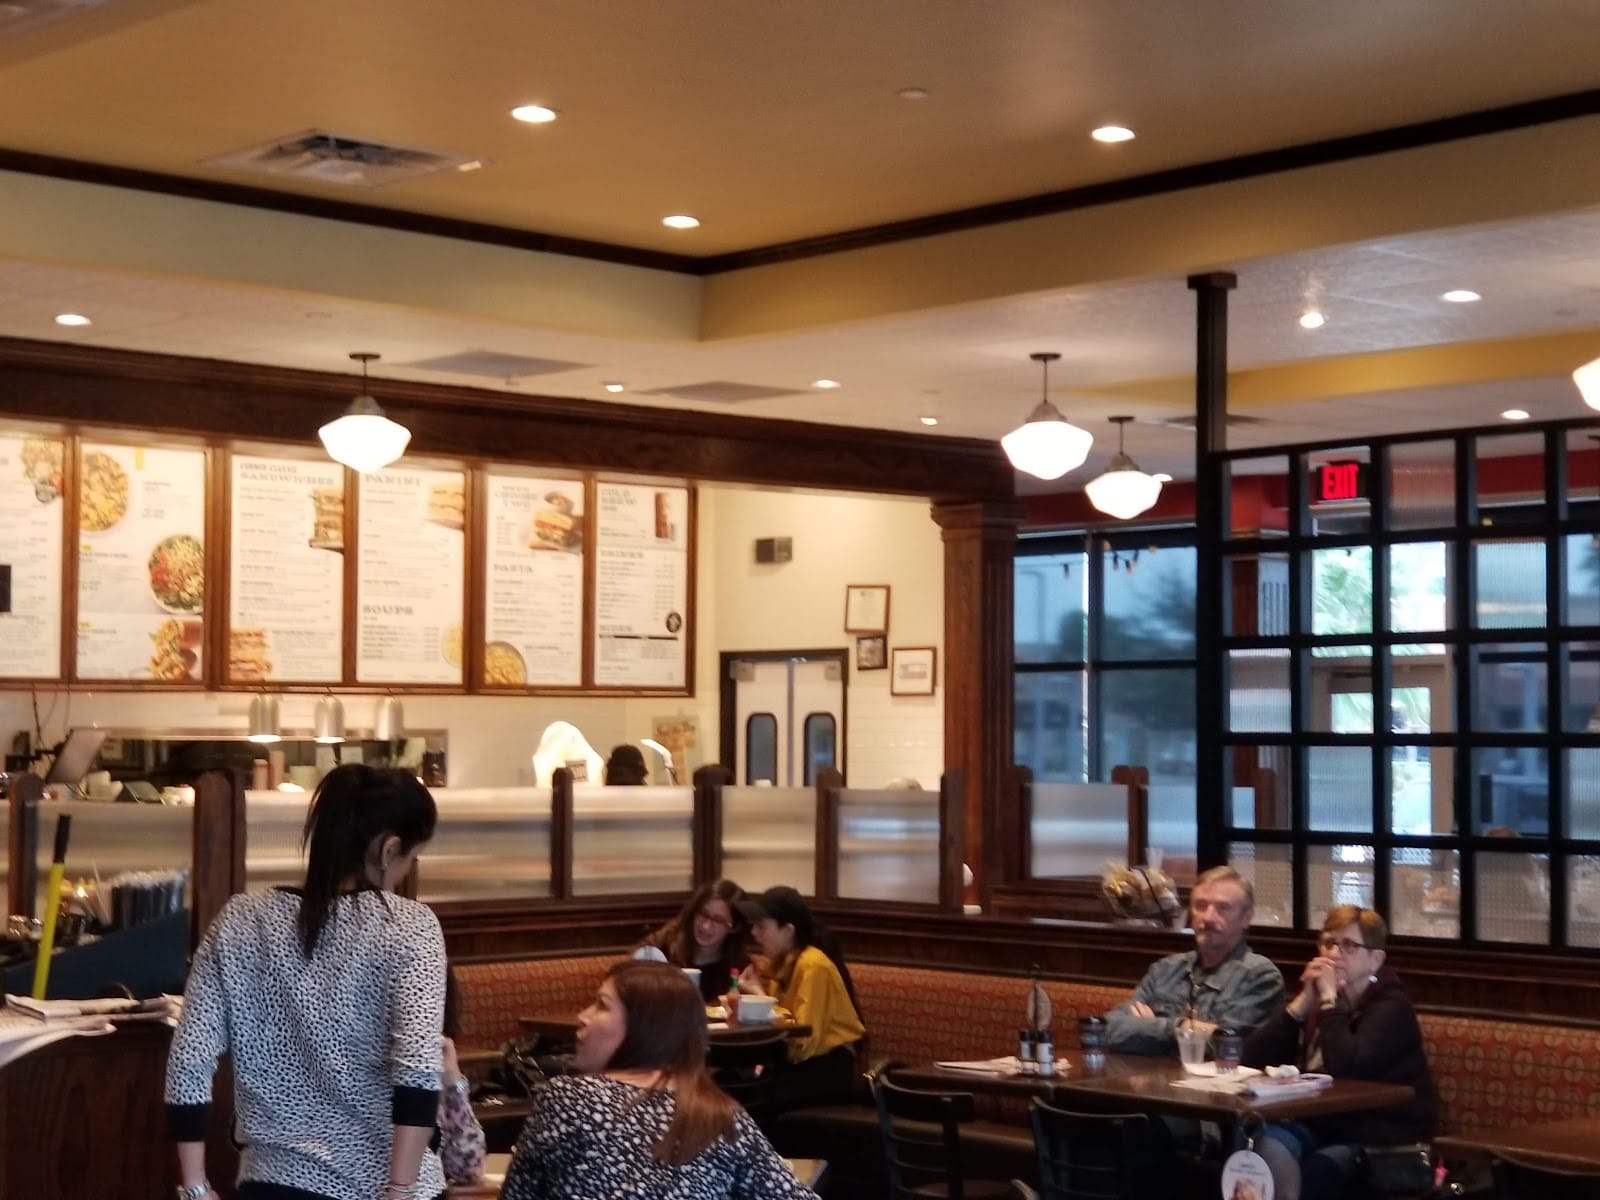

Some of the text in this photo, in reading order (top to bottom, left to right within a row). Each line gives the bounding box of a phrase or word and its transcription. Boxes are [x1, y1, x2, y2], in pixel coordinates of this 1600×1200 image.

[364, 473, 422, 486] PANINI
[1323, 463, 1359, 500] EXIT
[493, 564, 535, 573] PASTA
[362, 604, 415, 616] SOUPS
